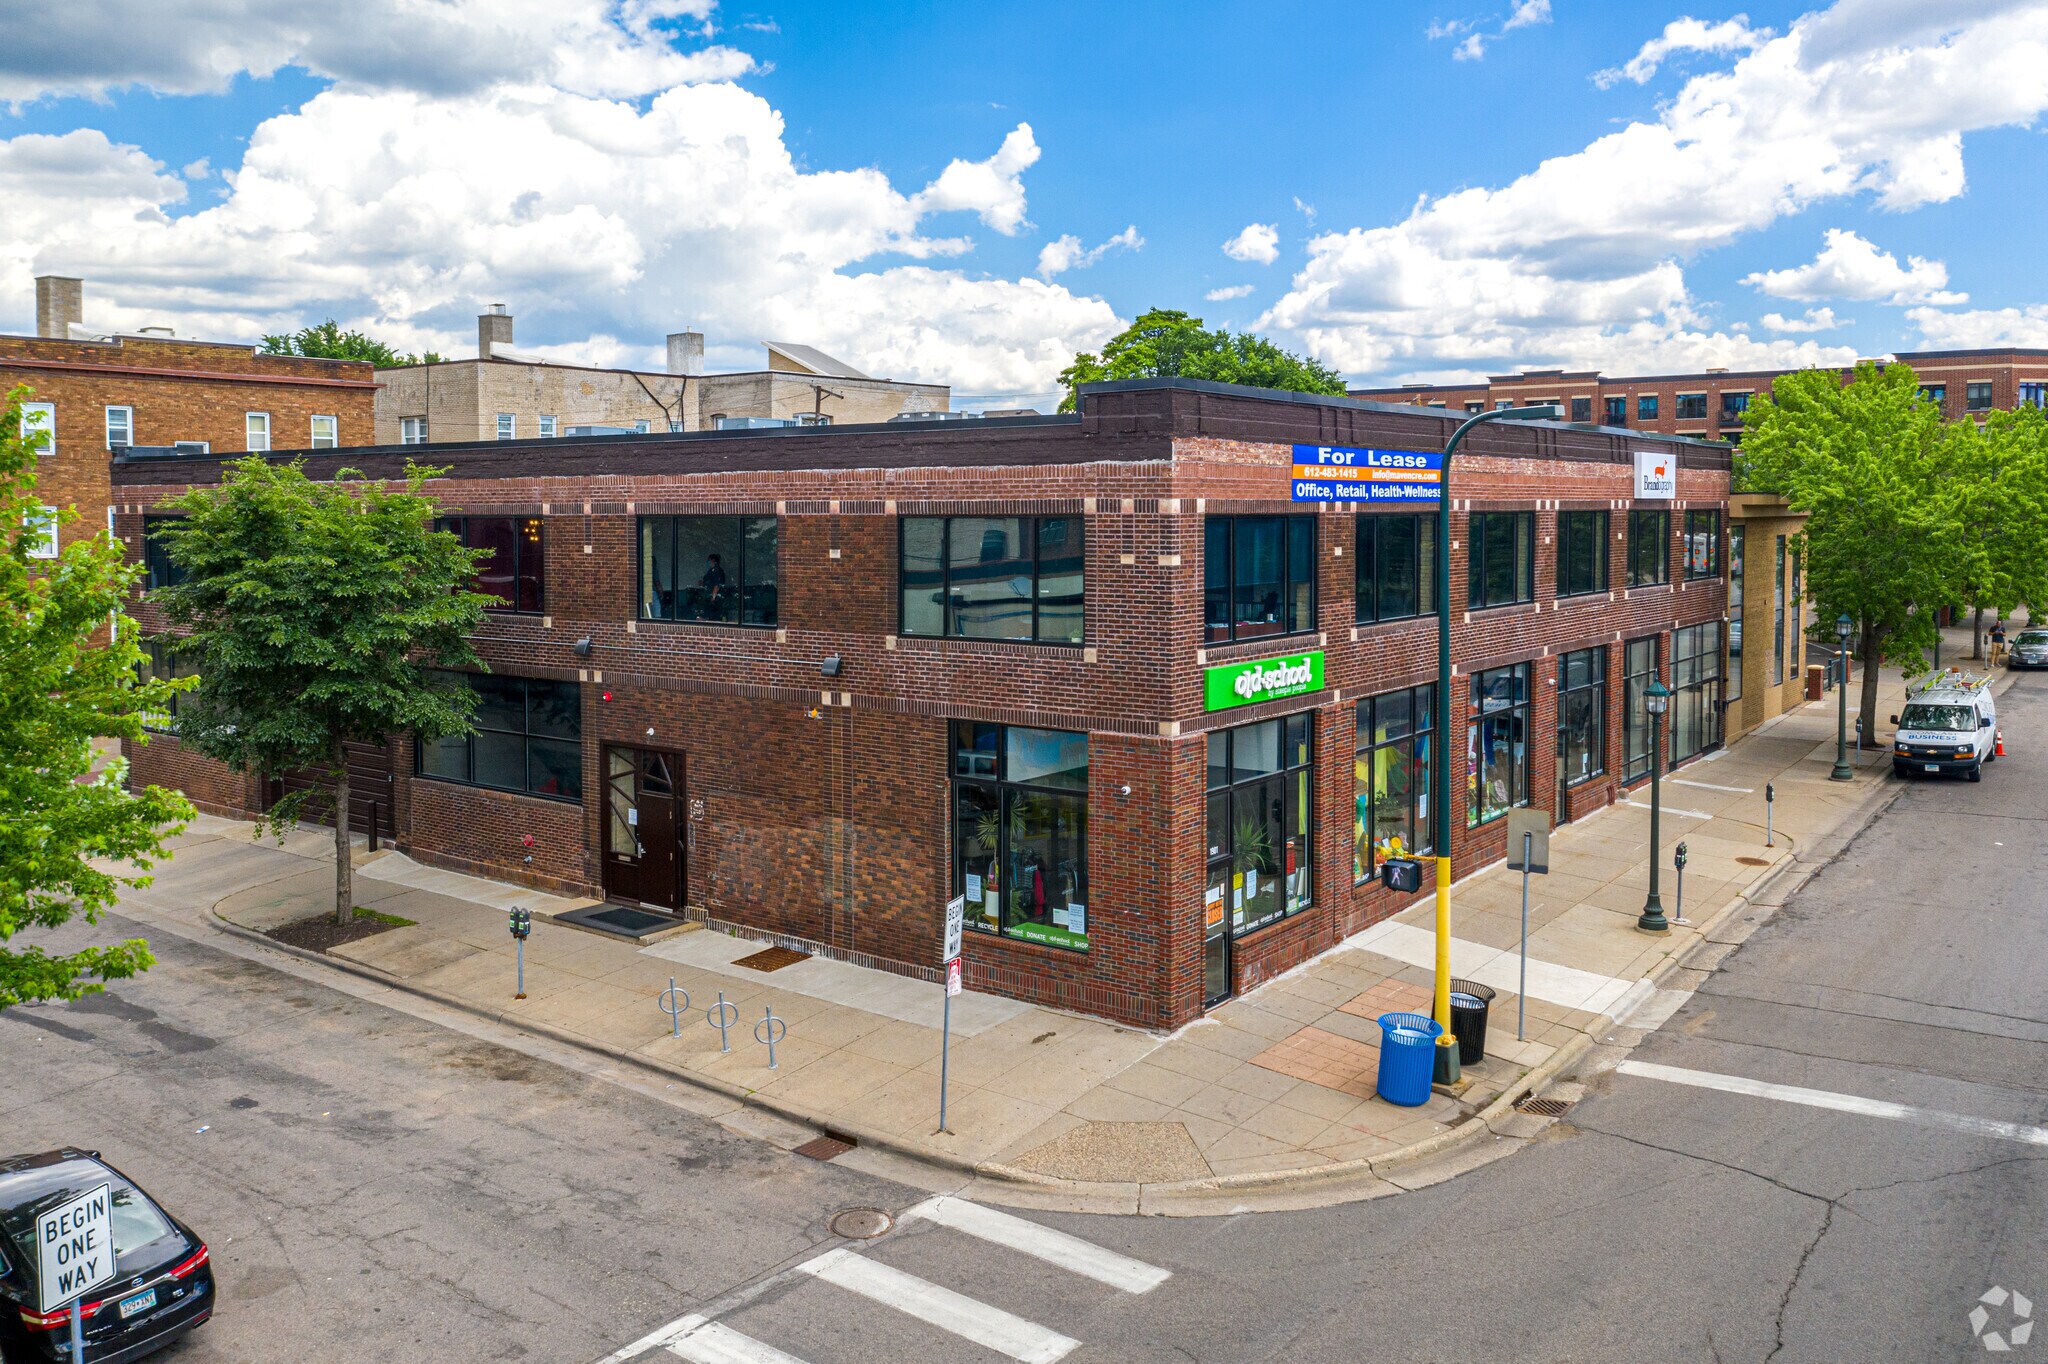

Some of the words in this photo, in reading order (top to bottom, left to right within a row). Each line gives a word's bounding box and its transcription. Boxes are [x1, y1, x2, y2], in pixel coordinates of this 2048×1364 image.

[1318, 447, 1355, 465] For
[1367, 450, 1427, 468] Lease
[1304, 466, 1358, 479] 612-483-1415
[1371, 469, 1438, 481] info@mavencre.com
[1296, 483, 1334, 500] Office,
[1336, 484, 1369, 499] Retail,
[977, 921, 999, 932] RECYCLE
[1026, 931, 1047, 941] DONATE
[1074, 941, 1089, 949] SHOP
[45, 1195, 104, 1244] BEGIN
[57, 1228, 97, 1265] ONE
[58, 1256, 98, 1295] WAY
[123, 1301, 136, 1314] 329
